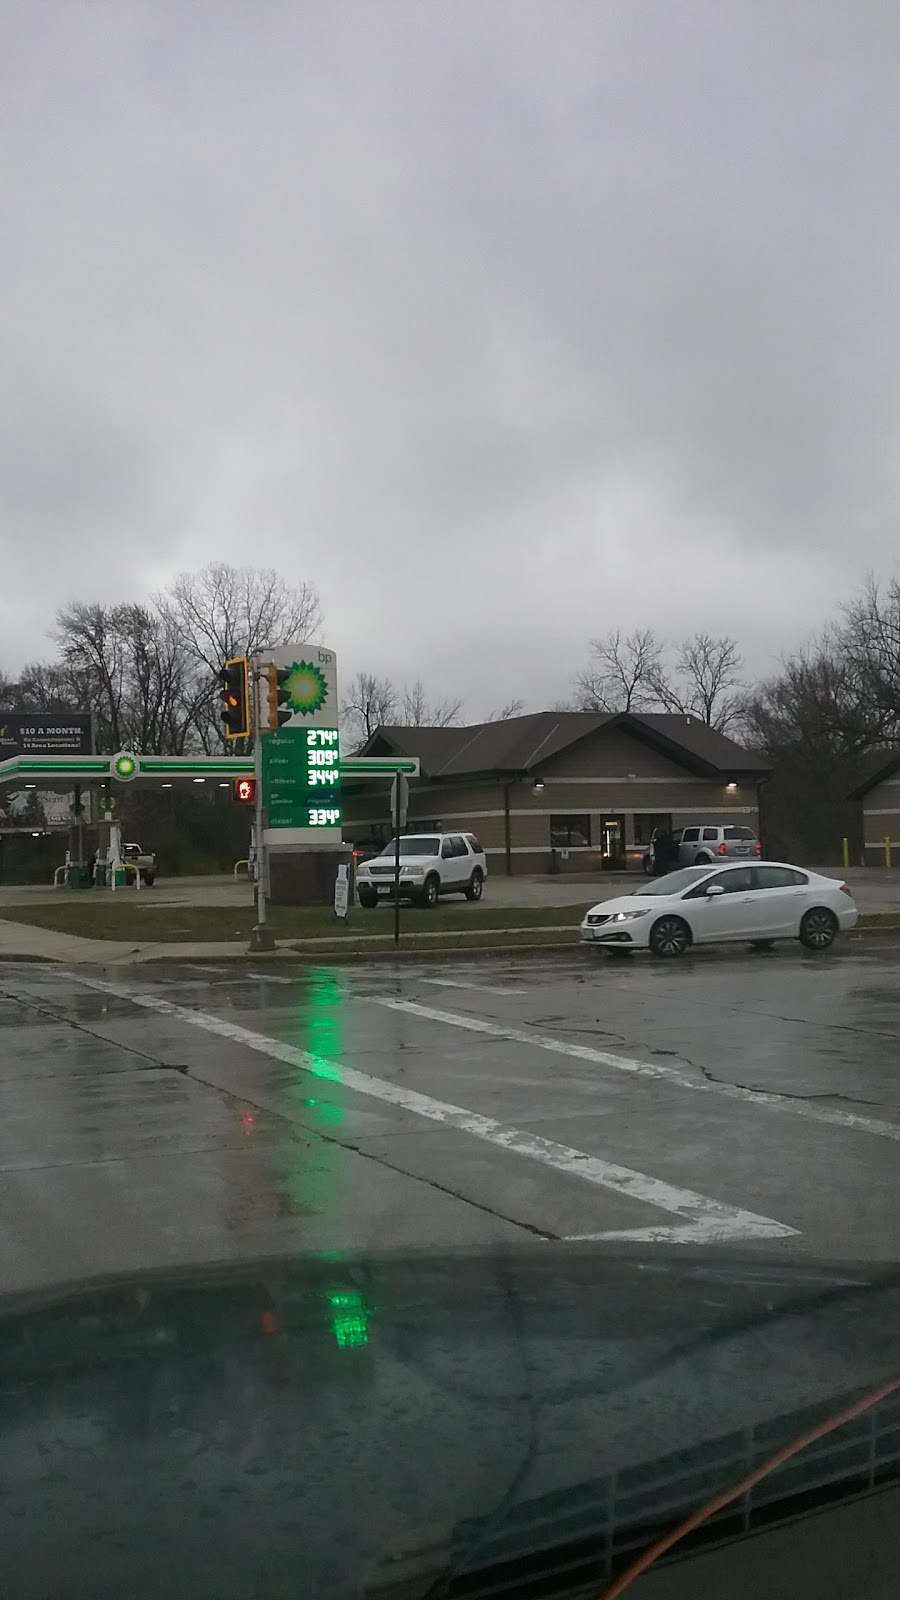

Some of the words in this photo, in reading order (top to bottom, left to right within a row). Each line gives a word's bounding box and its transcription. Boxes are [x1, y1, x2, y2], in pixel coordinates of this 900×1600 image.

[318, 650, 332, 664] bp
[20, 727, 35, 735] $10
[37, 727, 44, 735] A
